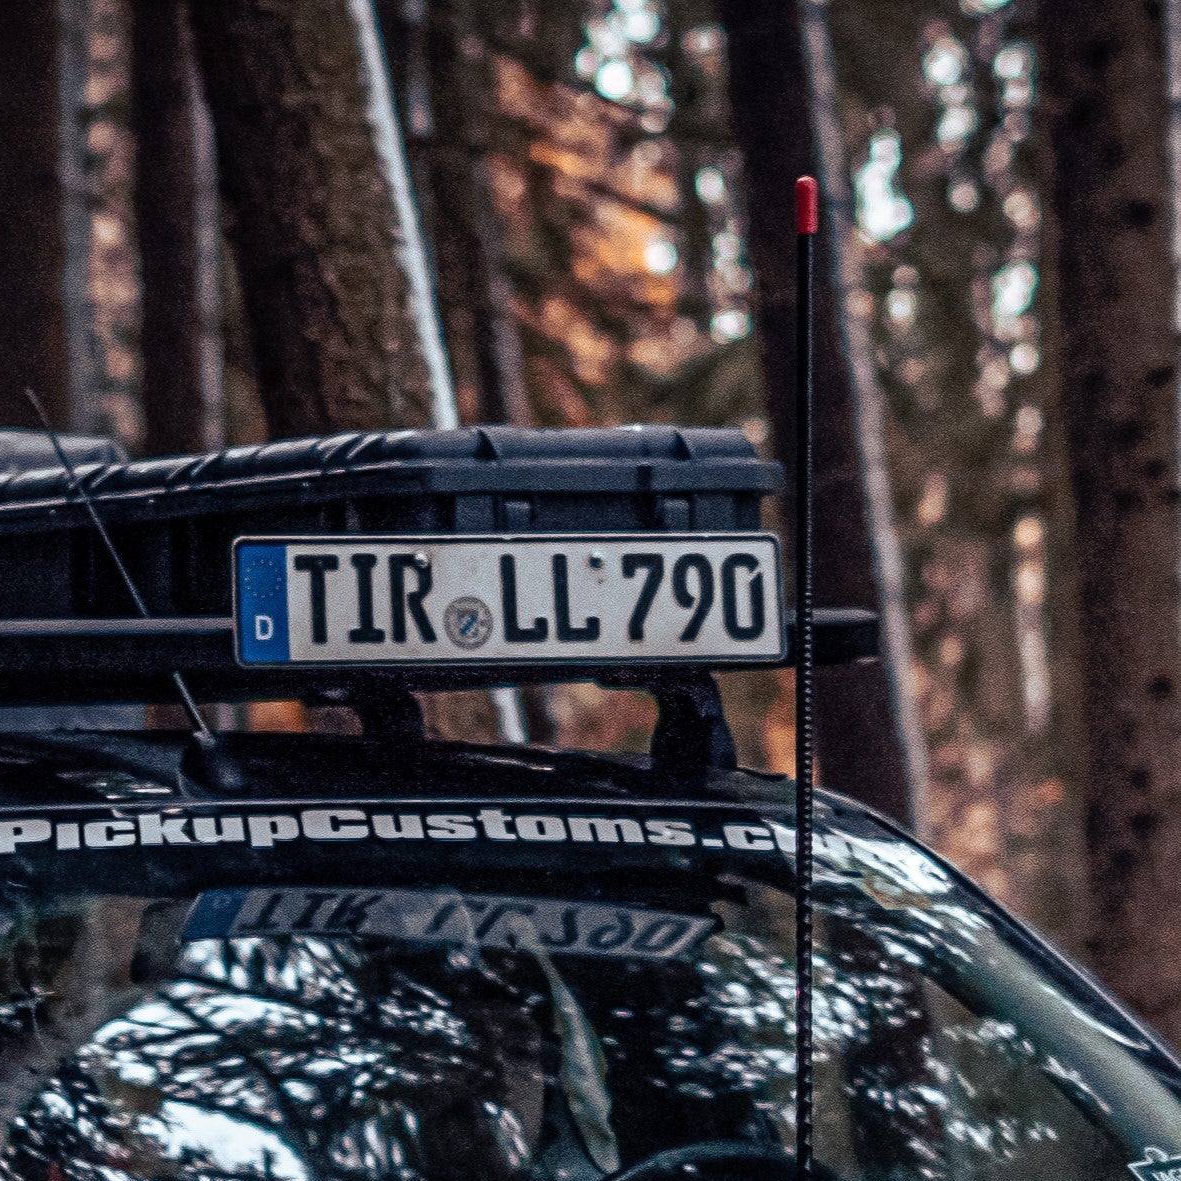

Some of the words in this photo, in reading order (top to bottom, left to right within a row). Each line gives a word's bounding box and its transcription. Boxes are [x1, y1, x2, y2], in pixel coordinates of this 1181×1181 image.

[255, 615, 274, 641] D
[293, 552, 438, 644] TIR
[499, 553, 601, 643] LL
[621, 552, 766, 642] 790
